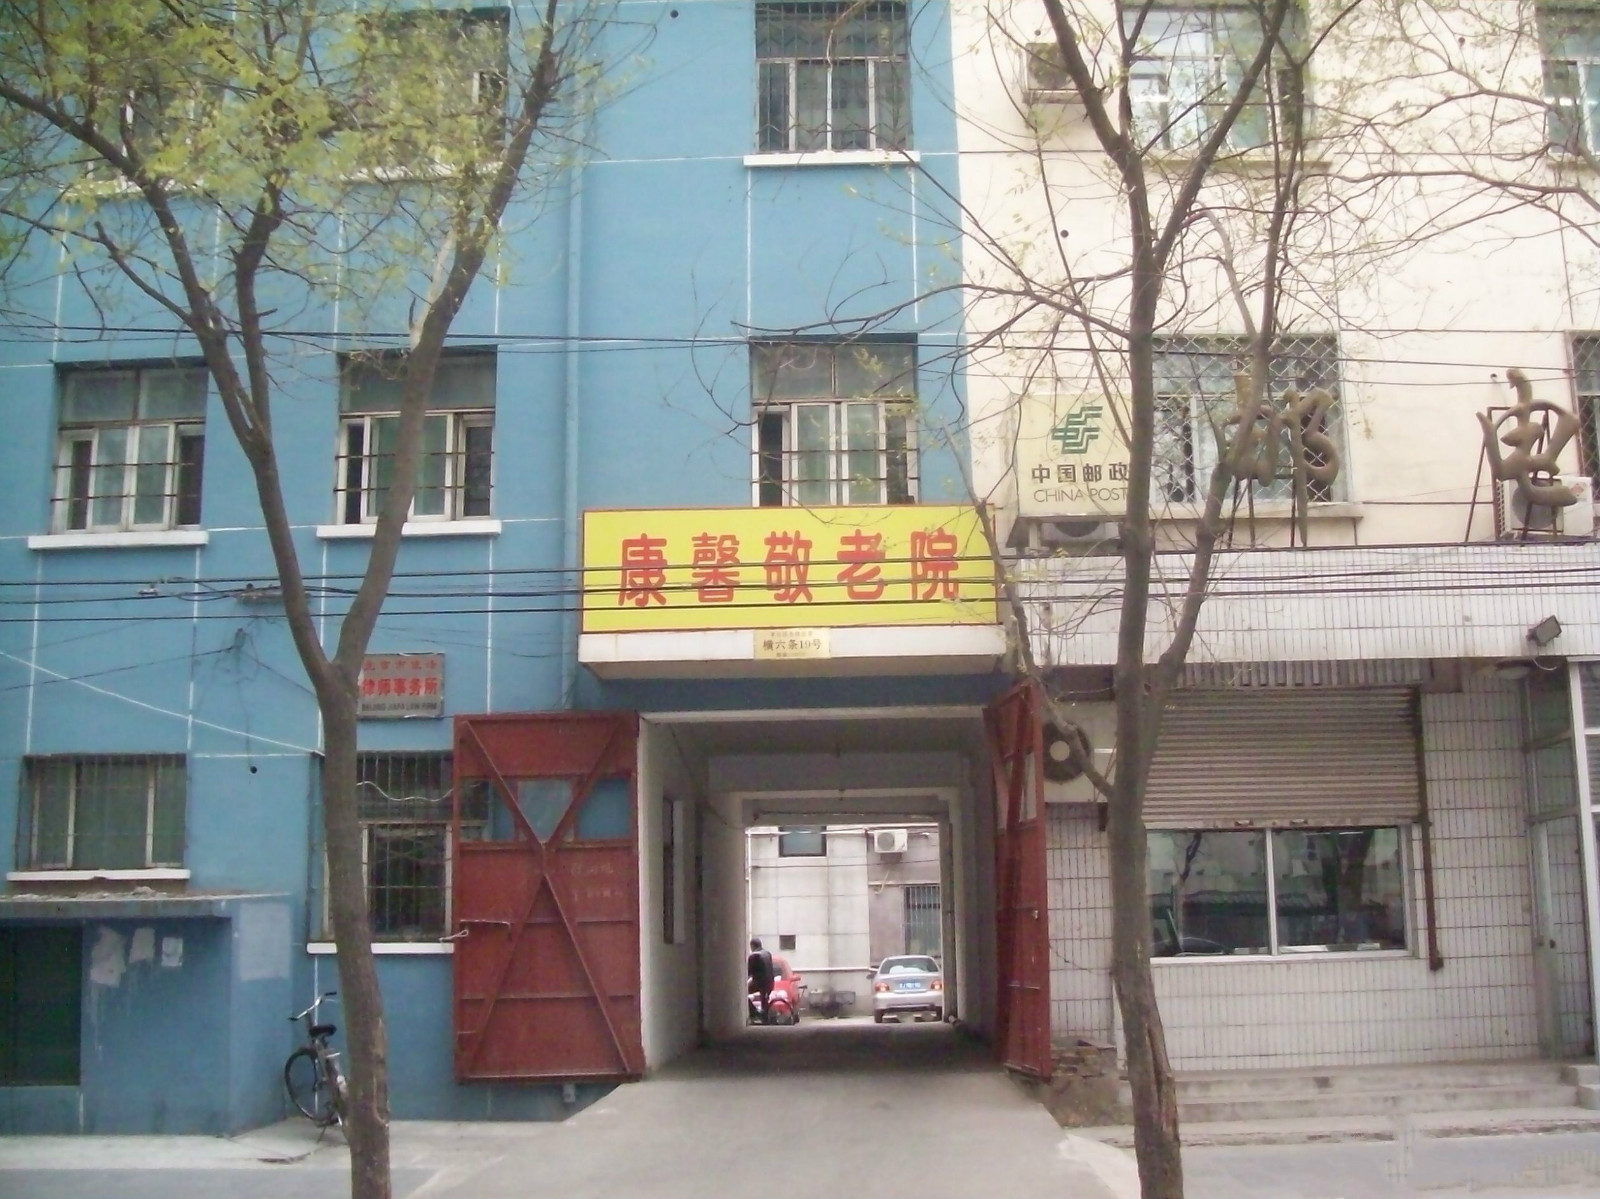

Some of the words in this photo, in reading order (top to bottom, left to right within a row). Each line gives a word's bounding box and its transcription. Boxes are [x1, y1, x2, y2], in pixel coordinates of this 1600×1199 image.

[1031, 462, 1129, 483] 中国邮政
[1033, 488, 1083, 502] CHINA
[1089, 487, 1129, 501] POST
[618, 527, 960, 607] 康馨敬老院
[362, 677, 438, 697] 律师事务所
